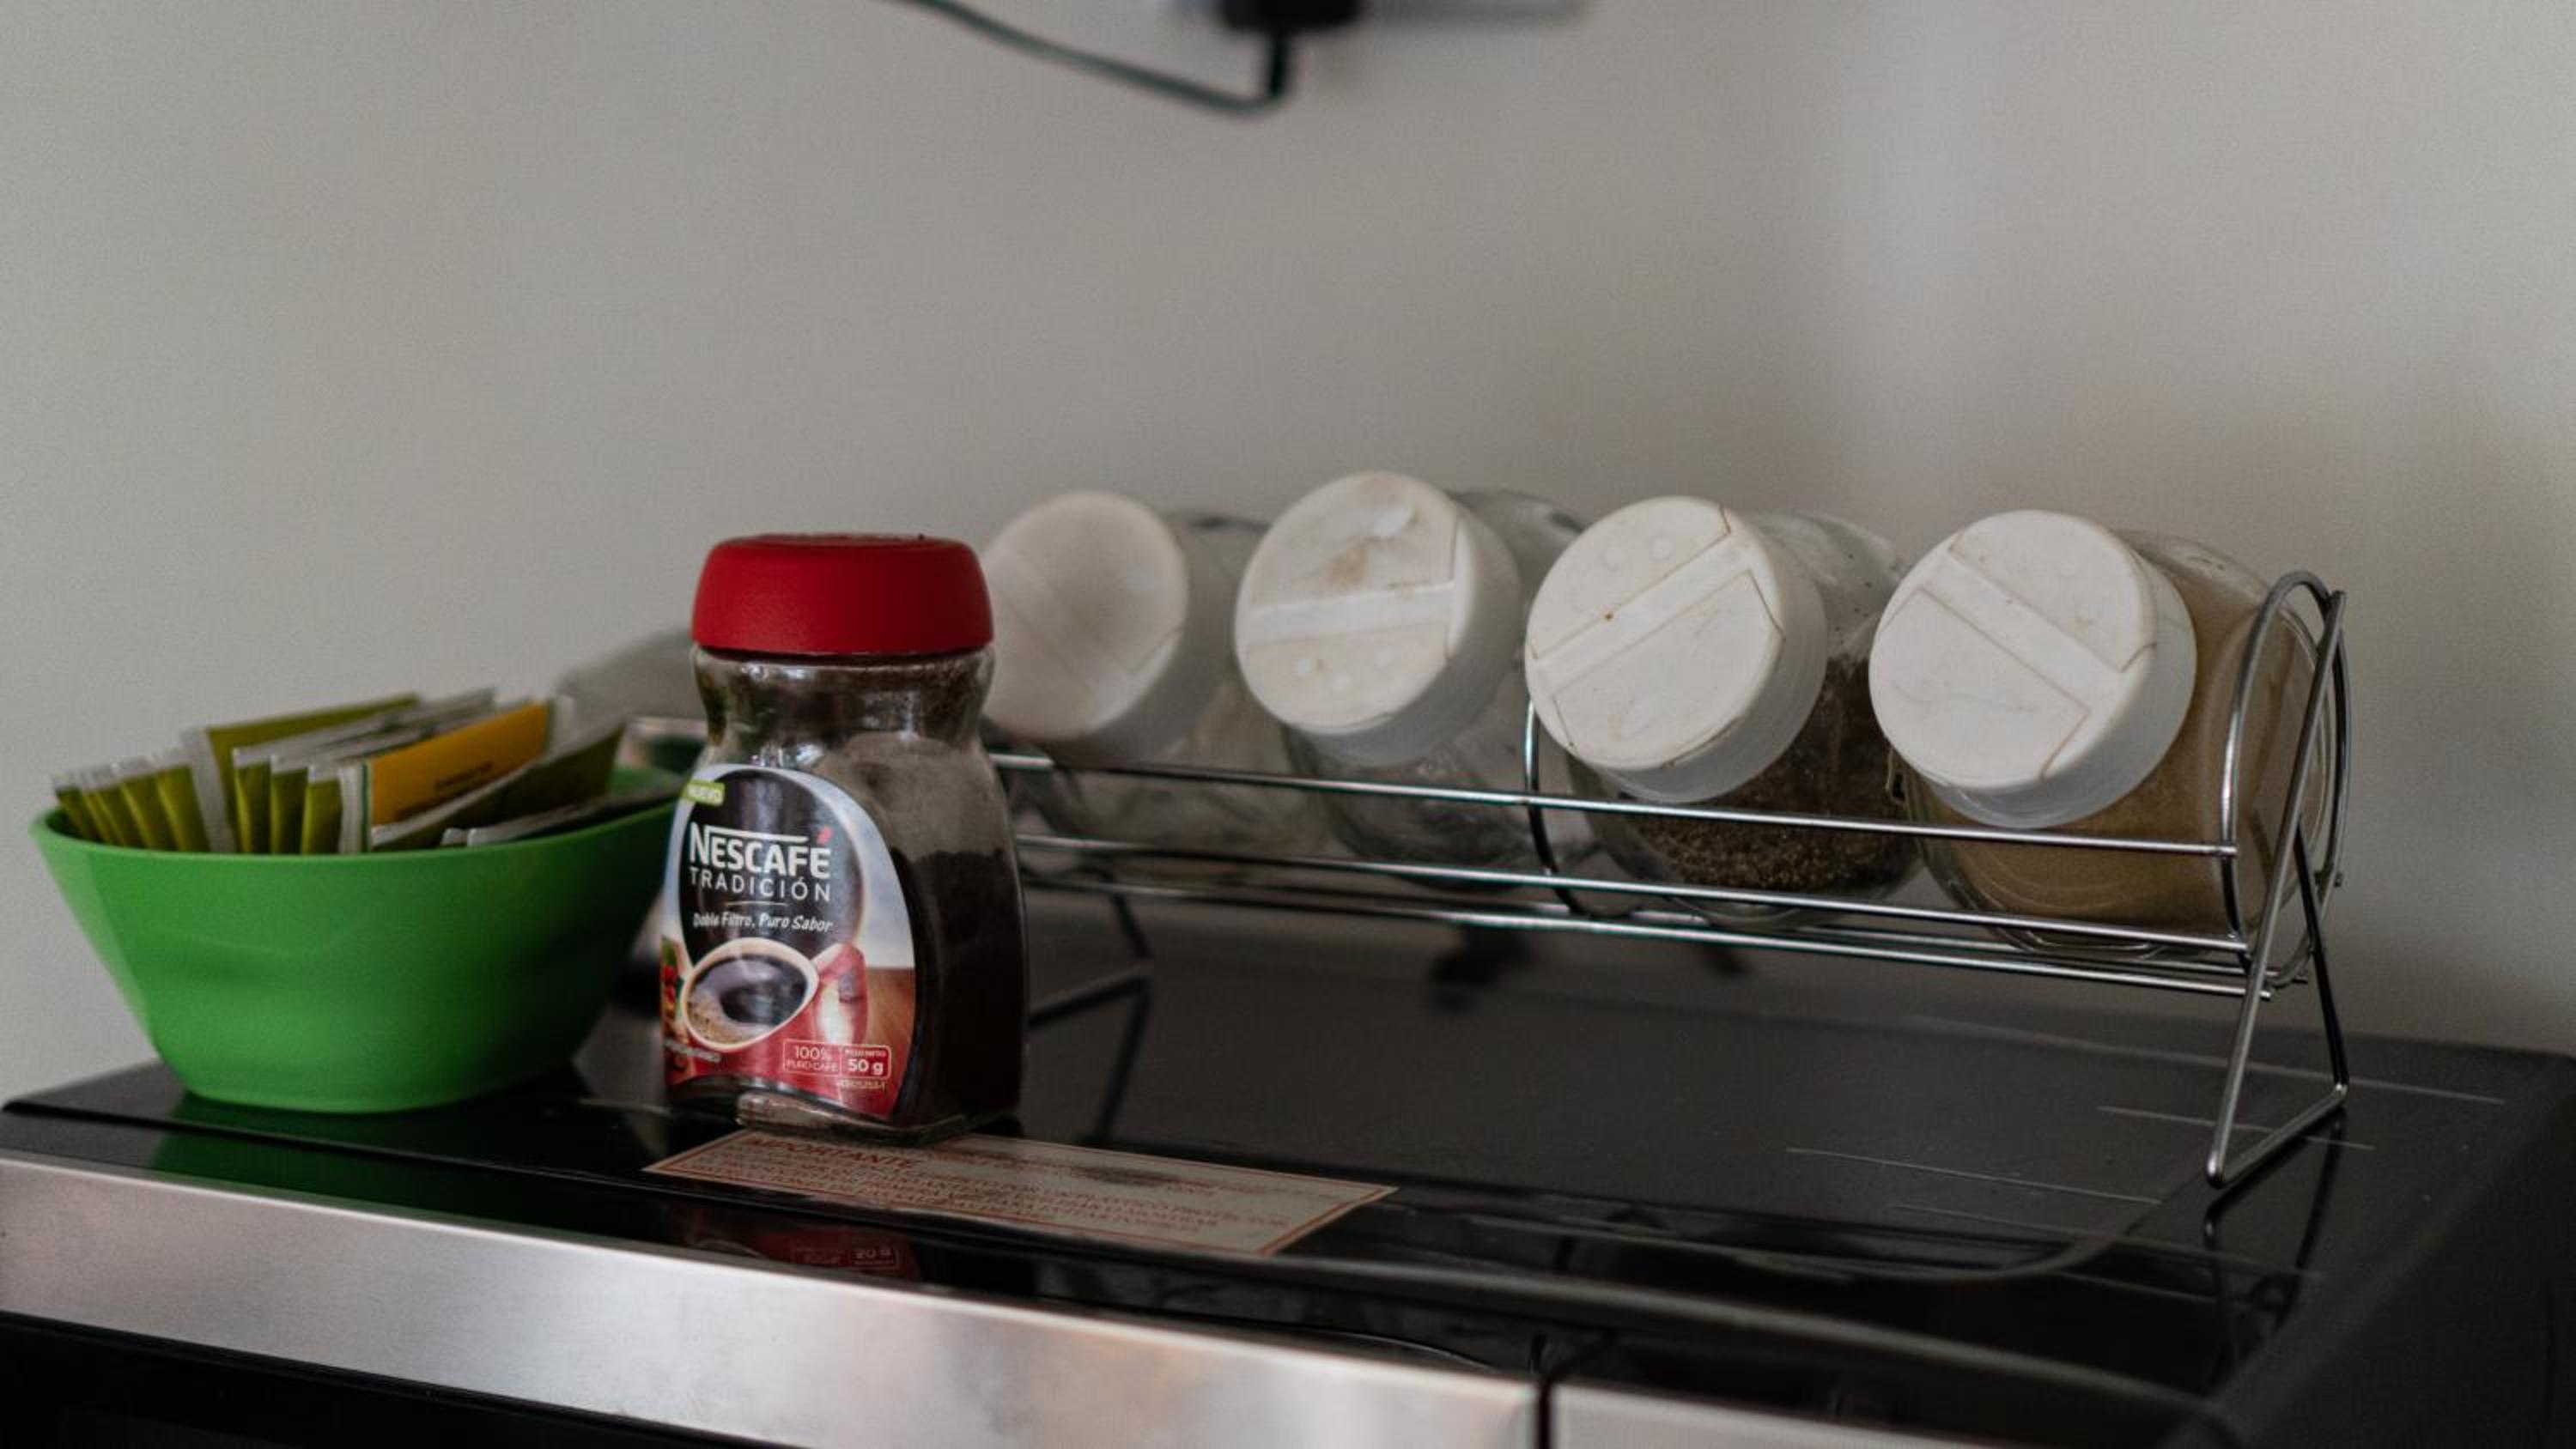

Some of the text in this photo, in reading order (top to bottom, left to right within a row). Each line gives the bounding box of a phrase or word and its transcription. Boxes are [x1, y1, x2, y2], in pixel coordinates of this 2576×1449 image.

[690, 822, 833, 880] NESCAFÉ
[690, 866, 830, 901] TRADICIÓN
[693, 911, 834, 932] Doble Filtro, Puro Sabor
[795, 1045, 832, 1062] 100%
[848, 1058, 884, 1076] 50 g
